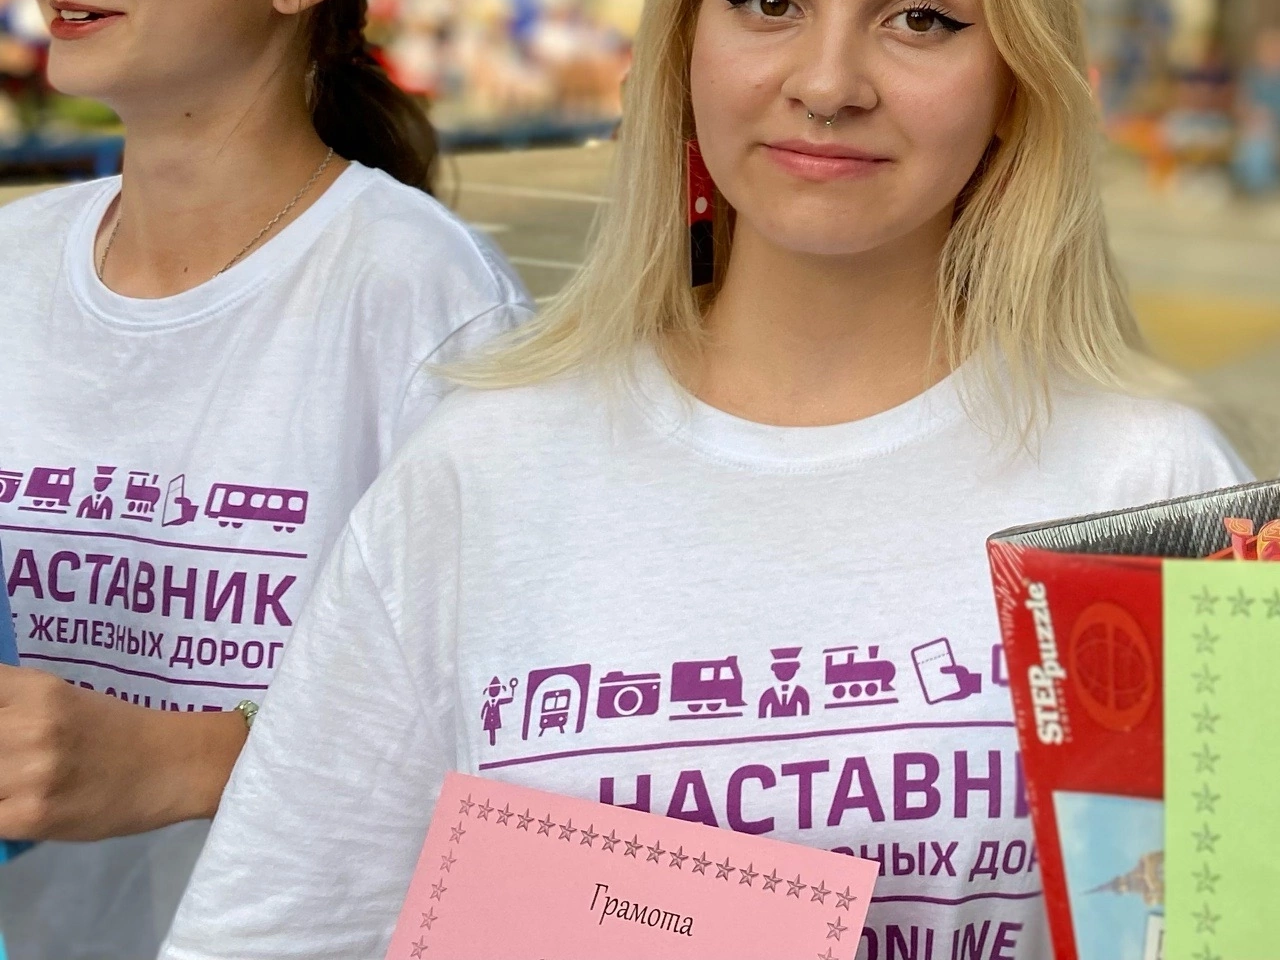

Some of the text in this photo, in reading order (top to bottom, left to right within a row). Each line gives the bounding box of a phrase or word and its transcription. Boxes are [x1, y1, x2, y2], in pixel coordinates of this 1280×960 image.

[7, 548, 298, 627] АСТАВНИК
[29, 613, 165, 660] ЖЕЛЕЗНЫХ
[169, 637, 284, 670] ДОРОГ
[589, 882, 694, 937] Грамота
